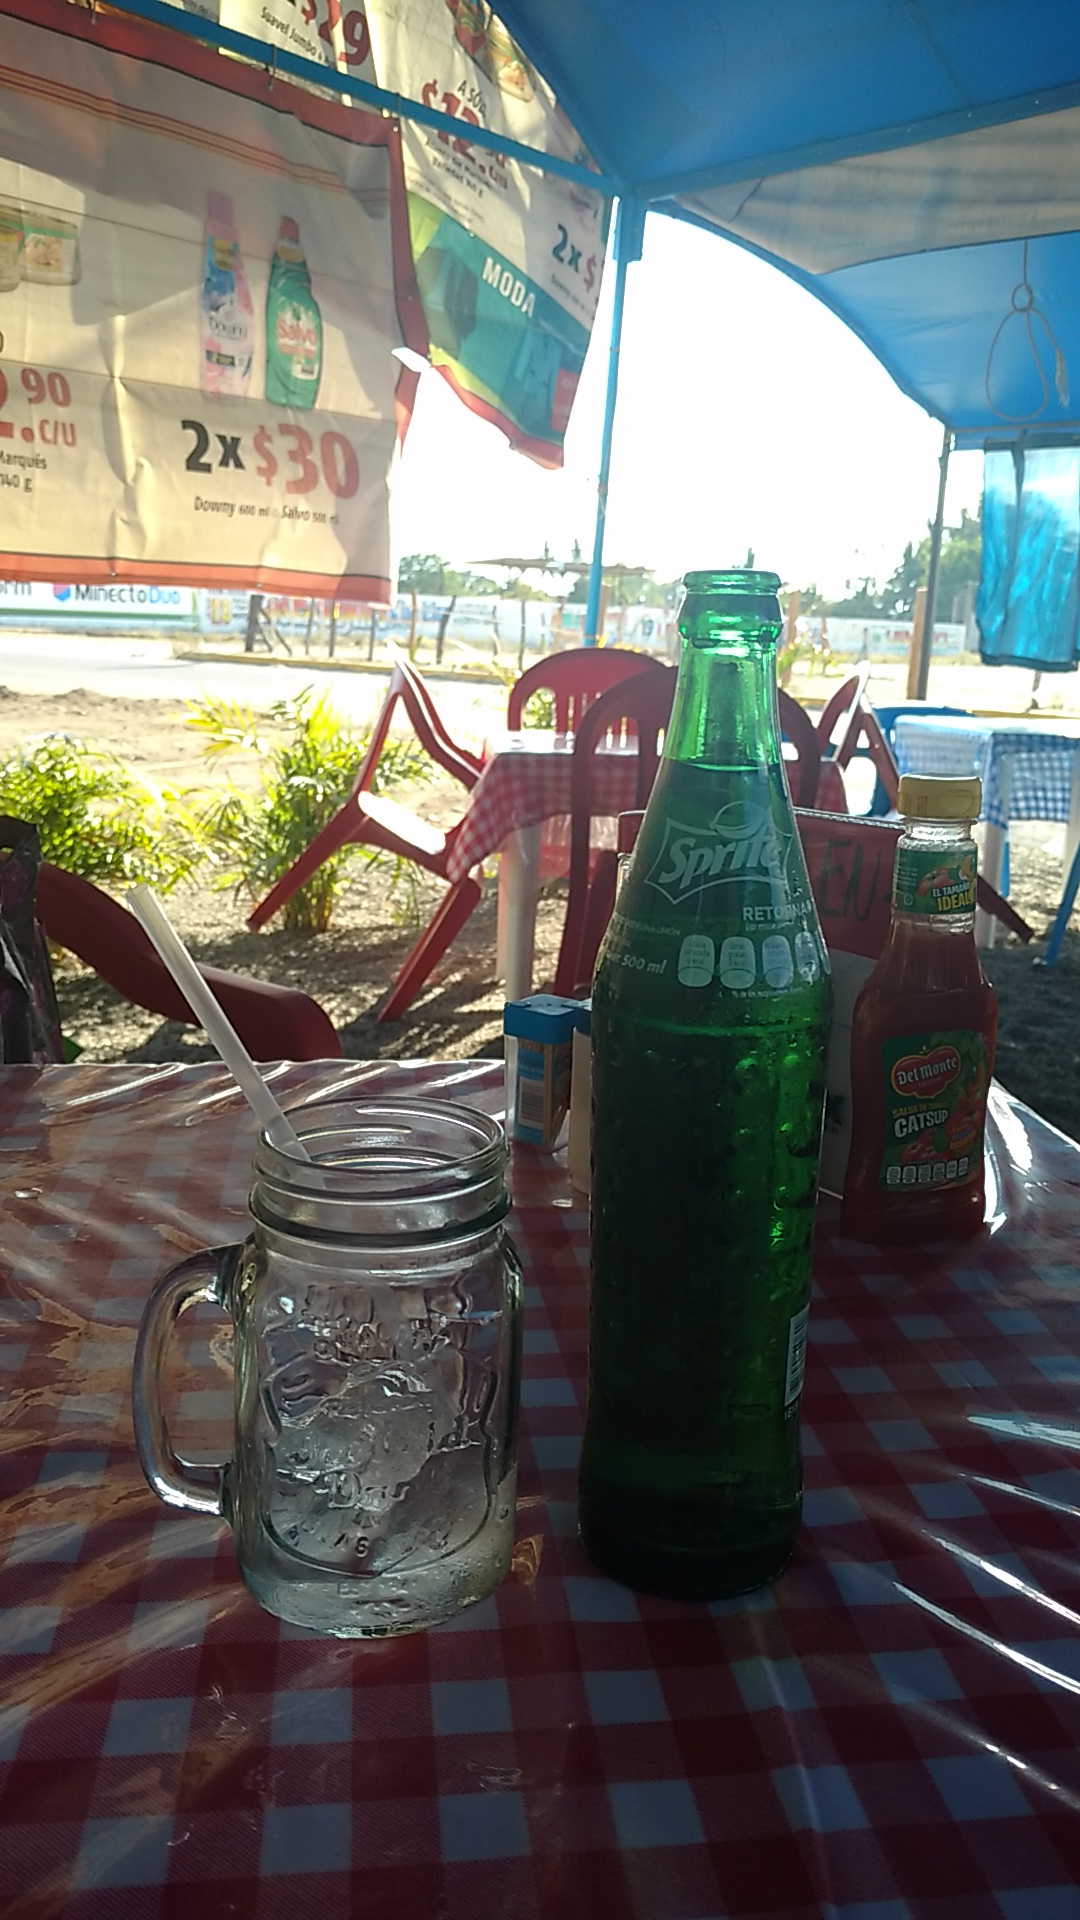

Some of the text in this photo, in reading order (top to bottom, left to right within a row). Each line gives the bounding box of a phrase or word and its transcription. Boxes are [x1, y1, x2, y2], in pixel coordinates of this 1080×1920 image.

[288, 27, 317, 57] Jumbo
[482, 256, 536, 318] MODA
[21, 368, 71, 408] 90
[39, 419, 76, 447] C/U
[193, 496, 236, 518] Downy
[281, 505, 310, 521] Salvo
[658, 828, 782, 890] Sprite
[936, 891, 971, 912] IDEAL
[621, 954, 646, 971] 500
[646, 959, 669, 974] ml
[897, 1070, 919, 1085] Del
[921, 1056, 958, 1080] Monte
[894, 1109, 949, 1138] CATSUP
